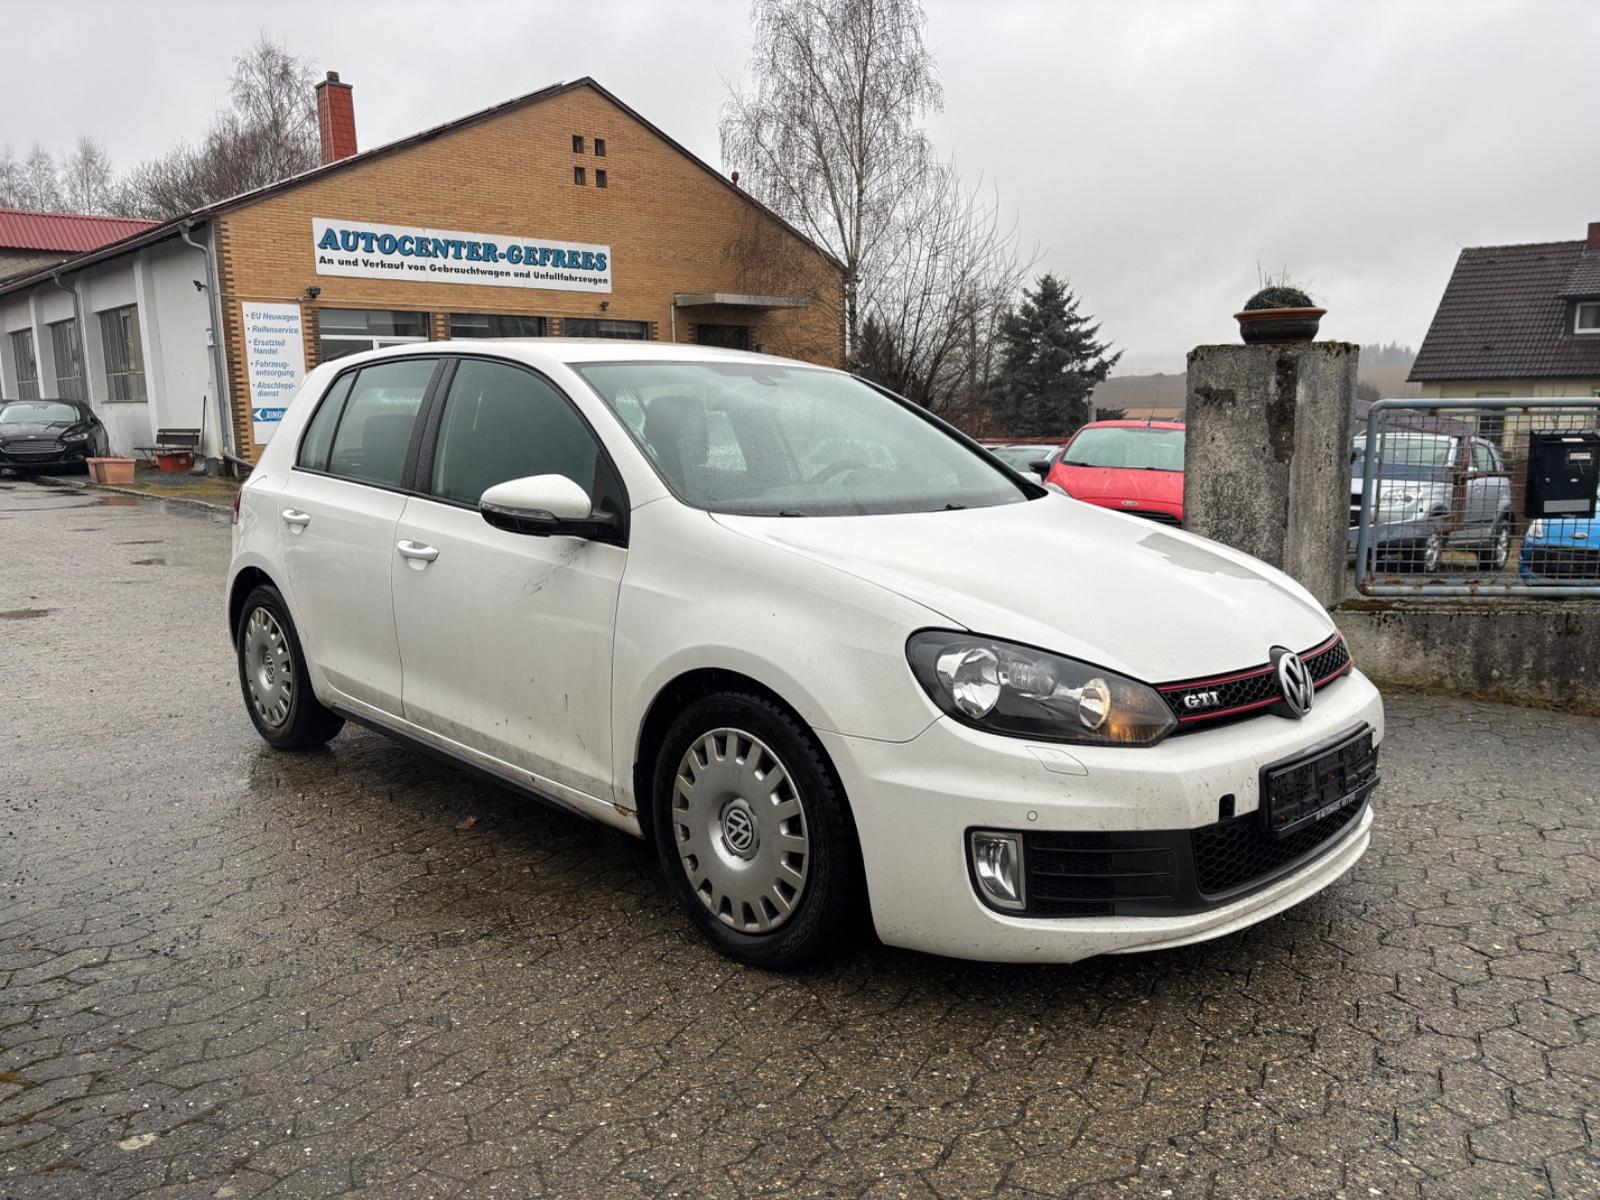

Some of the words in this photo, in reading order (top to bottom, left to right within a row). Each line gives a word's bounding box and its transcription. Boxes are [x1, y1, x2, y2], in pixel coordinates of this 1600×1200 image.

[317, 228, 607, 271] AUTOCENTER-GEFREES
[319, 256, 334, 265] An
[338, 258, 358, 267] und
[361, 259, 404, 270] Verkauf
[407, 263, 426, 271] von
[429, 263, 511, 278] Gebrauchtwagen
[513, 270, 531, 279] und
[533, 271, 608, 285] Unfallfahrzeugen
[250, 311, 261, 319] EU
[262, 312, 299, 322] Neuwagen
[252, 324, 299, 334] Reifenservice
[253, 338, 285, 346] Ersatzteil
[253, 347, 278, 355] Handel
[255, 360, 290, 369] Fahrzeug-
[1184, 690, 1220, 709] GTI
